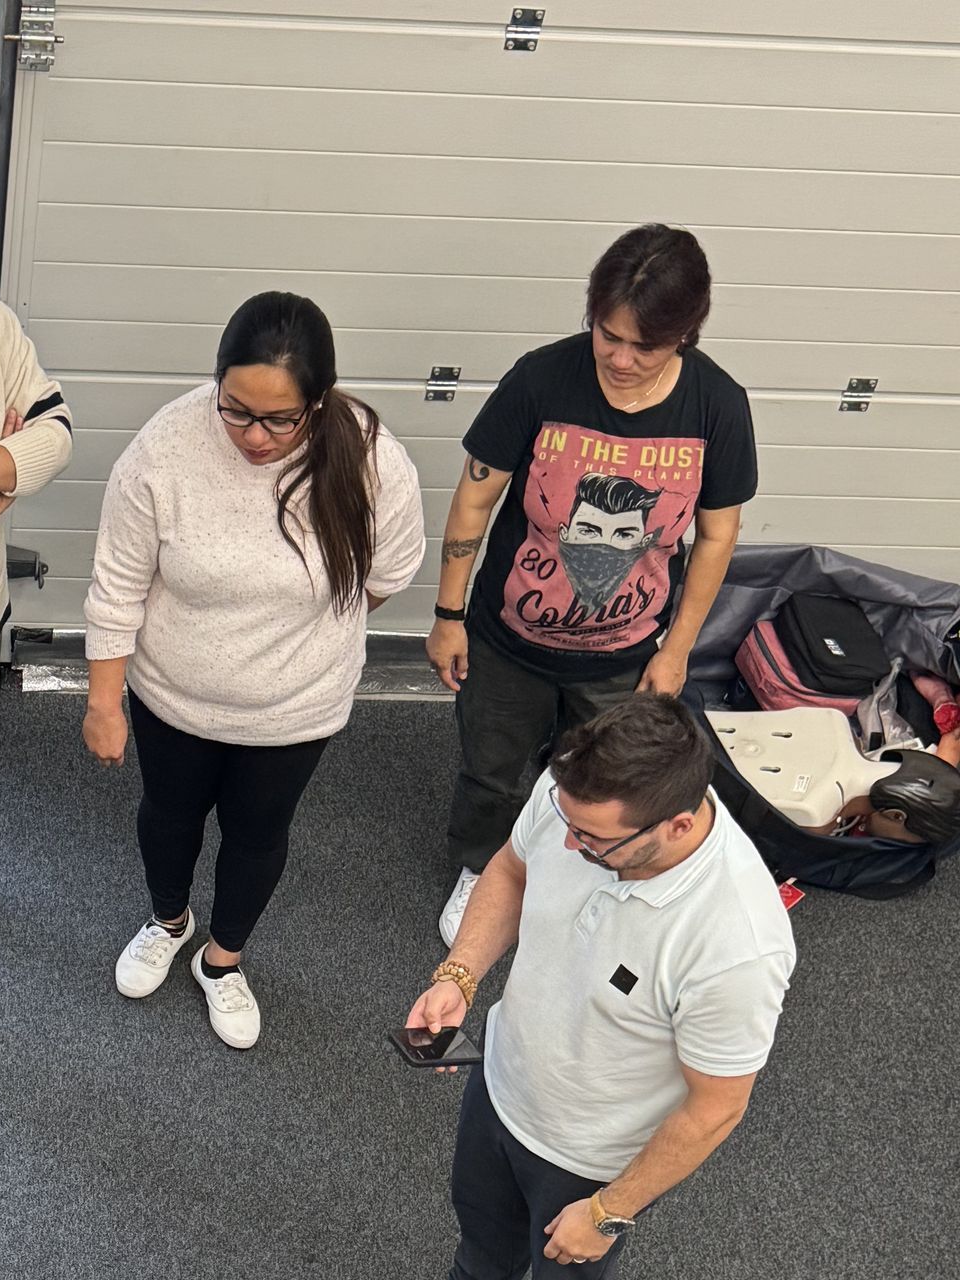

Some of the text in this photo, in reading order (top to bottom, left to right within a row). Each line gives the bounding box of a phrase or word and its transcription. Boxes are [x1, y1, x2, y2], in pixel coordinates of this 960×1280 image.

[541, 429, 568, 452] IN
[580, 436, 629, 465] THE
[538, 452, 558, 464] OF
[573, 460, 617, 475] THIS
[520, 548, 557, 580] 80
